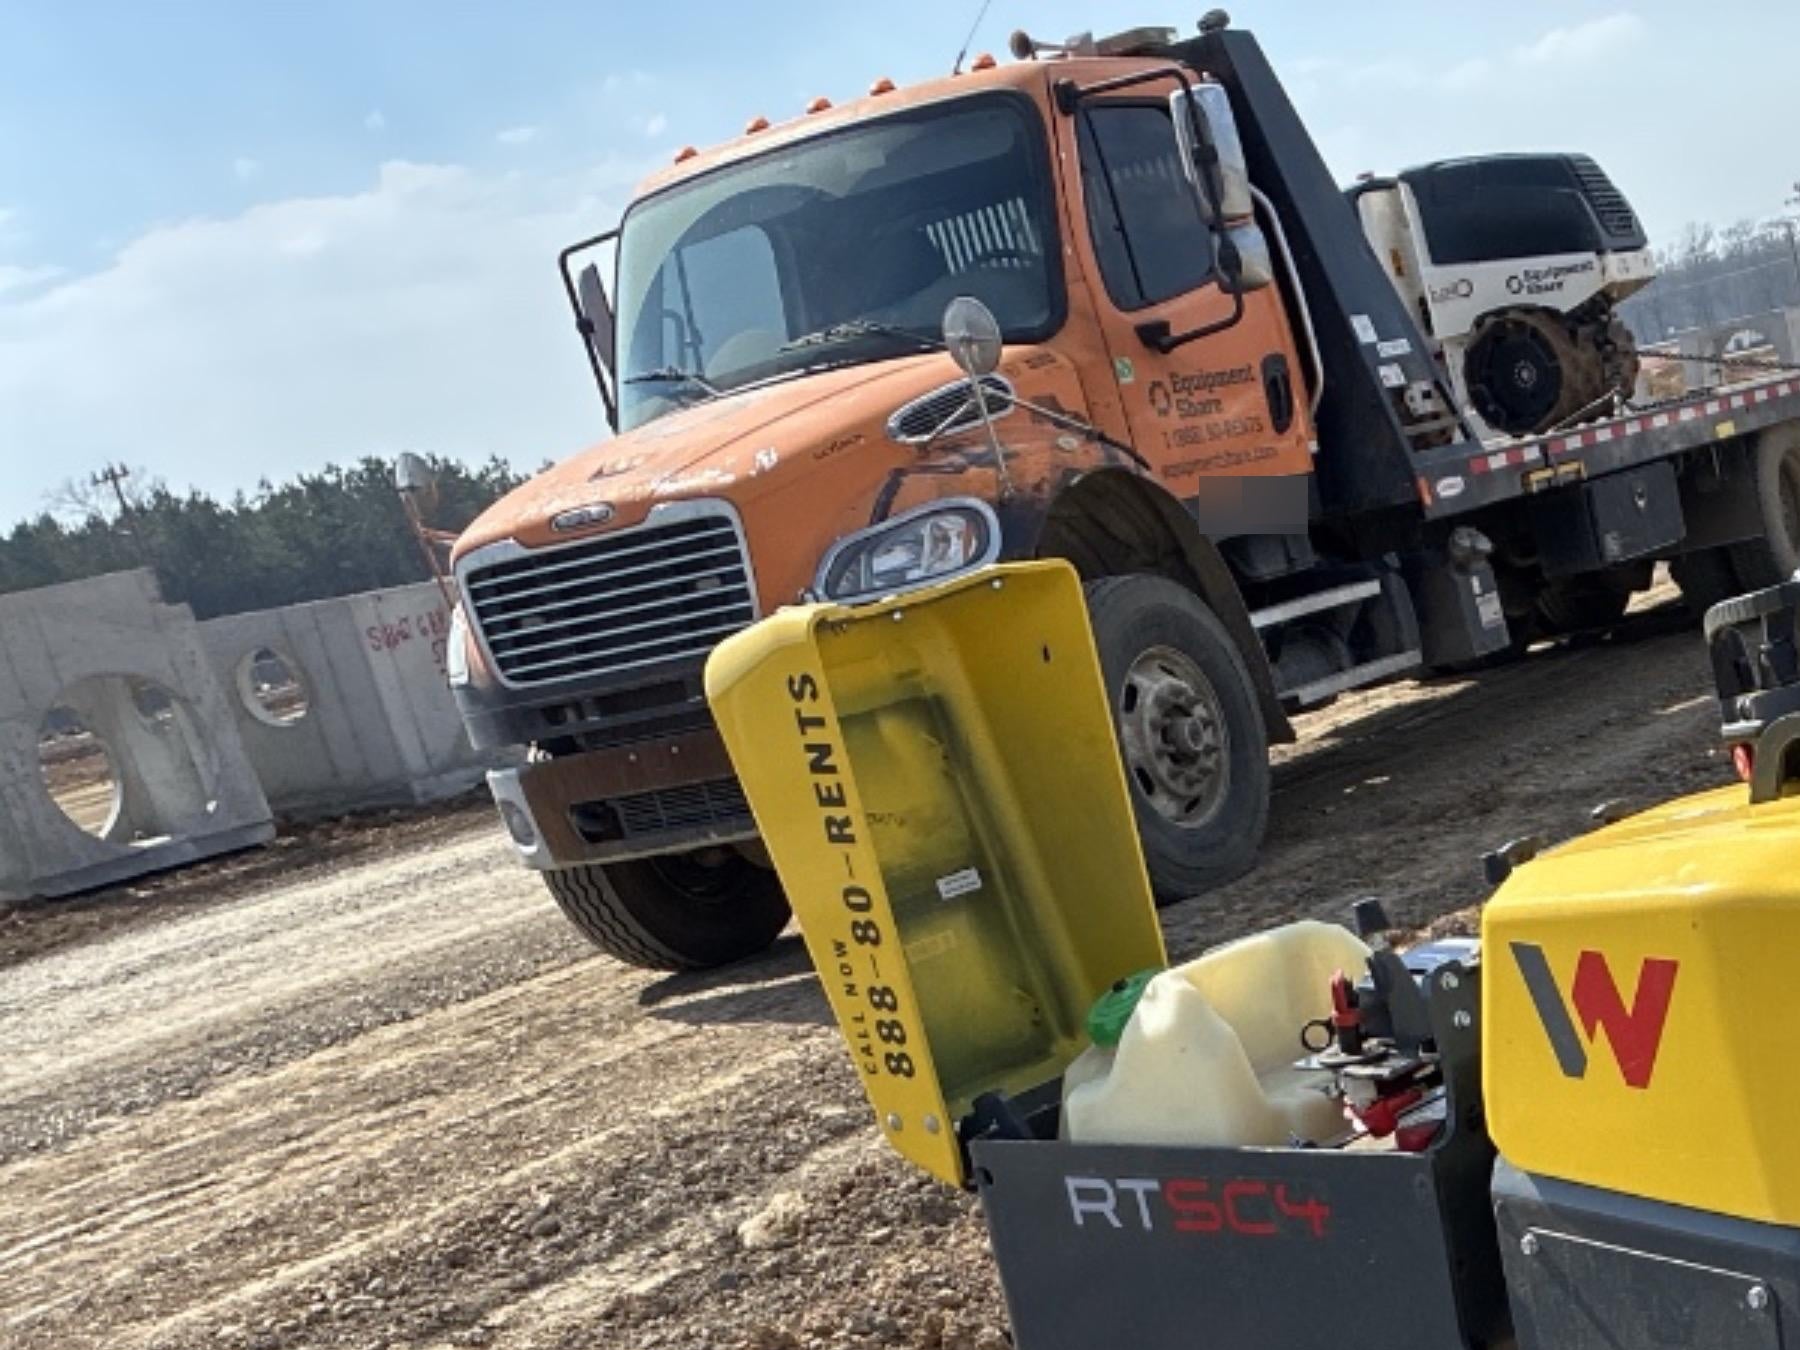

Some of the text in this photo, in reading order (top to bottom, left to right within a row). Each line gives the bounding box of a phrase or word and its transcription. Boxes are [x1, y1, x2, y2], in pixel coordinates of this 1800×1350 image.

[1170, 364, 1255, 396] Equipment
[1177, 399, 1222, 417] Share
[789, 672, 914, 1079] 888-80-RENTS
[834, 939, 878, 1076] CALL NOW
